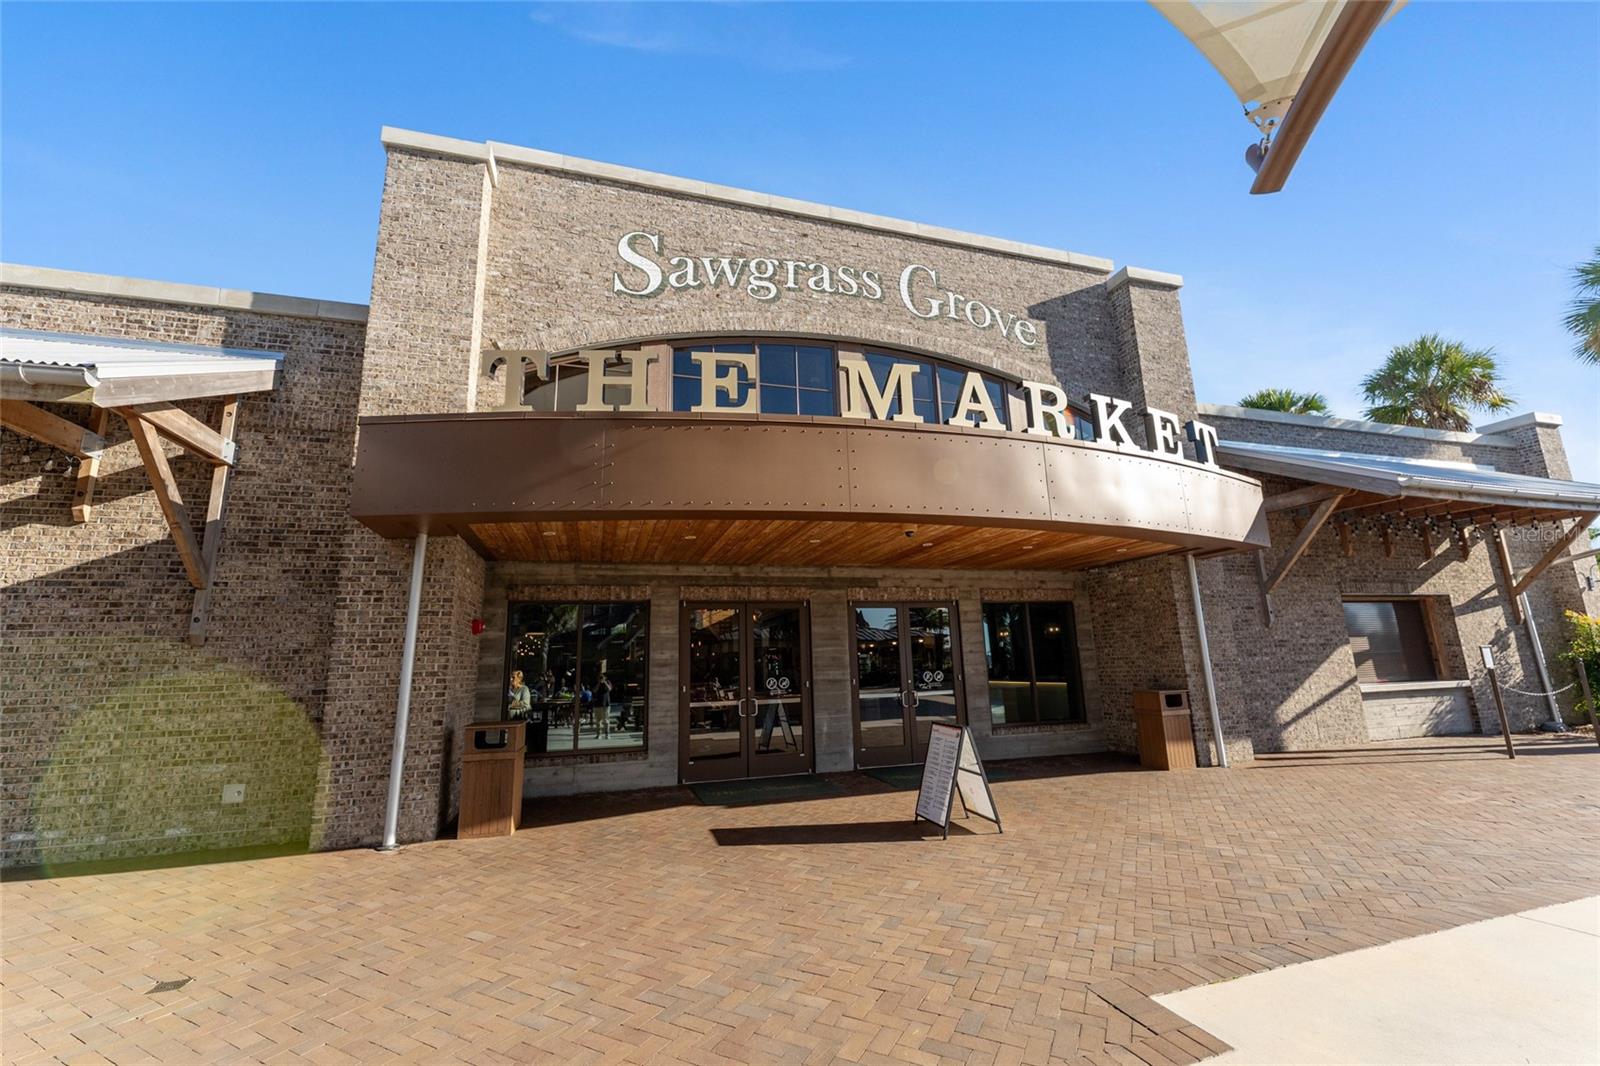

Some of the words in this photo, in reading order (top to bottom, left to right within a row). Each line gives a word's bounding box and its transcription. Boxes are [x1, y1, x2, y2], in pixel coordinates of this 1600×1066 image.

[613, 231, 883, 300] Sawgrass
[899, 264, 1037, 346] Grove
[482, 349, 758, 413] THE
[839, 358, 1221, 469] MARKET
